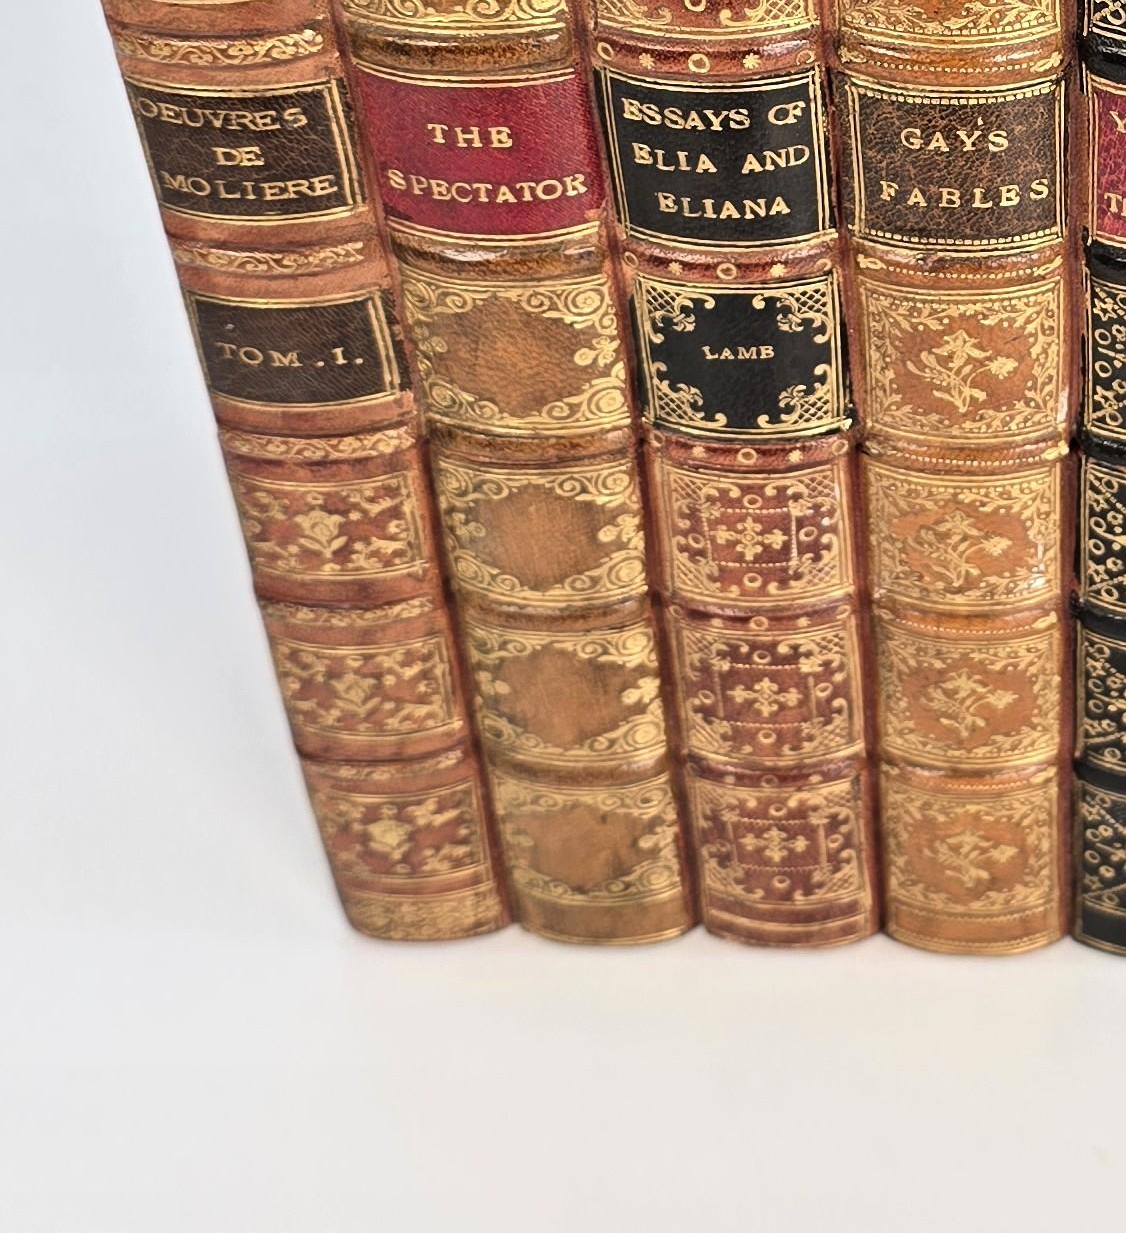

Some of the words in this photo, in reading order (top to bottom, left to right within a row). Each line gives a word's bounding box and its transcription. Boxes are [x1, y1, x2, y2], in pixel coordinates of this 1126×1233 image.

[136, 96, 308, 131] OEUVRES
[621, 98, 751, 131] ESSAYS
[767, 101, 807, 127] OF
[427, 122, 513, 148] THE
[900, 116, 1009, 153] GAY'S
[215, 146, 265, 167] DE
[631, 142, 718, 173] ELIA
[741, 144, 810, 174] AND
[160, 170, 338, 201] MOLIERE
[386, 169, 588, 204] SPECTATOR
[879, 178, 1049, 209] FABLES
[657, 192, 791, 220] ELIANA
[702, 344, 776, 361] LAMB
